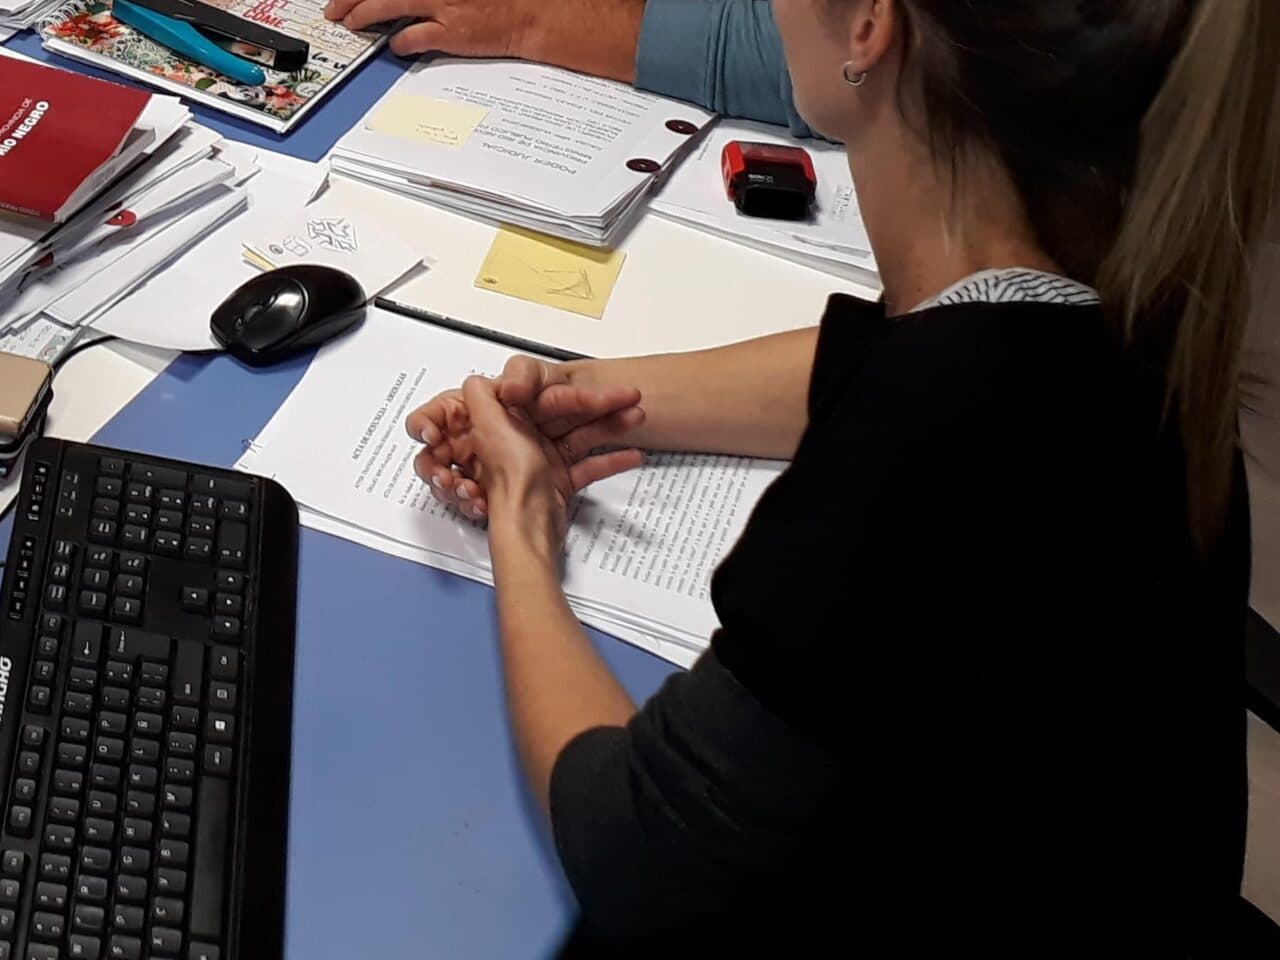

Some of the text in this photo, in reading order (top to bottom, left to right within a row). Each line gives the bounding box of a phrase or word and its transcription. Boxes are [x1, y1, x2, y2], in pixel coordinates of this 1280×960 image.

[243, 9, 287, 27] COME
[12, 101, 49, 139] NEGRO
[483, 142, 576, 175] PODER JUDICIAL
